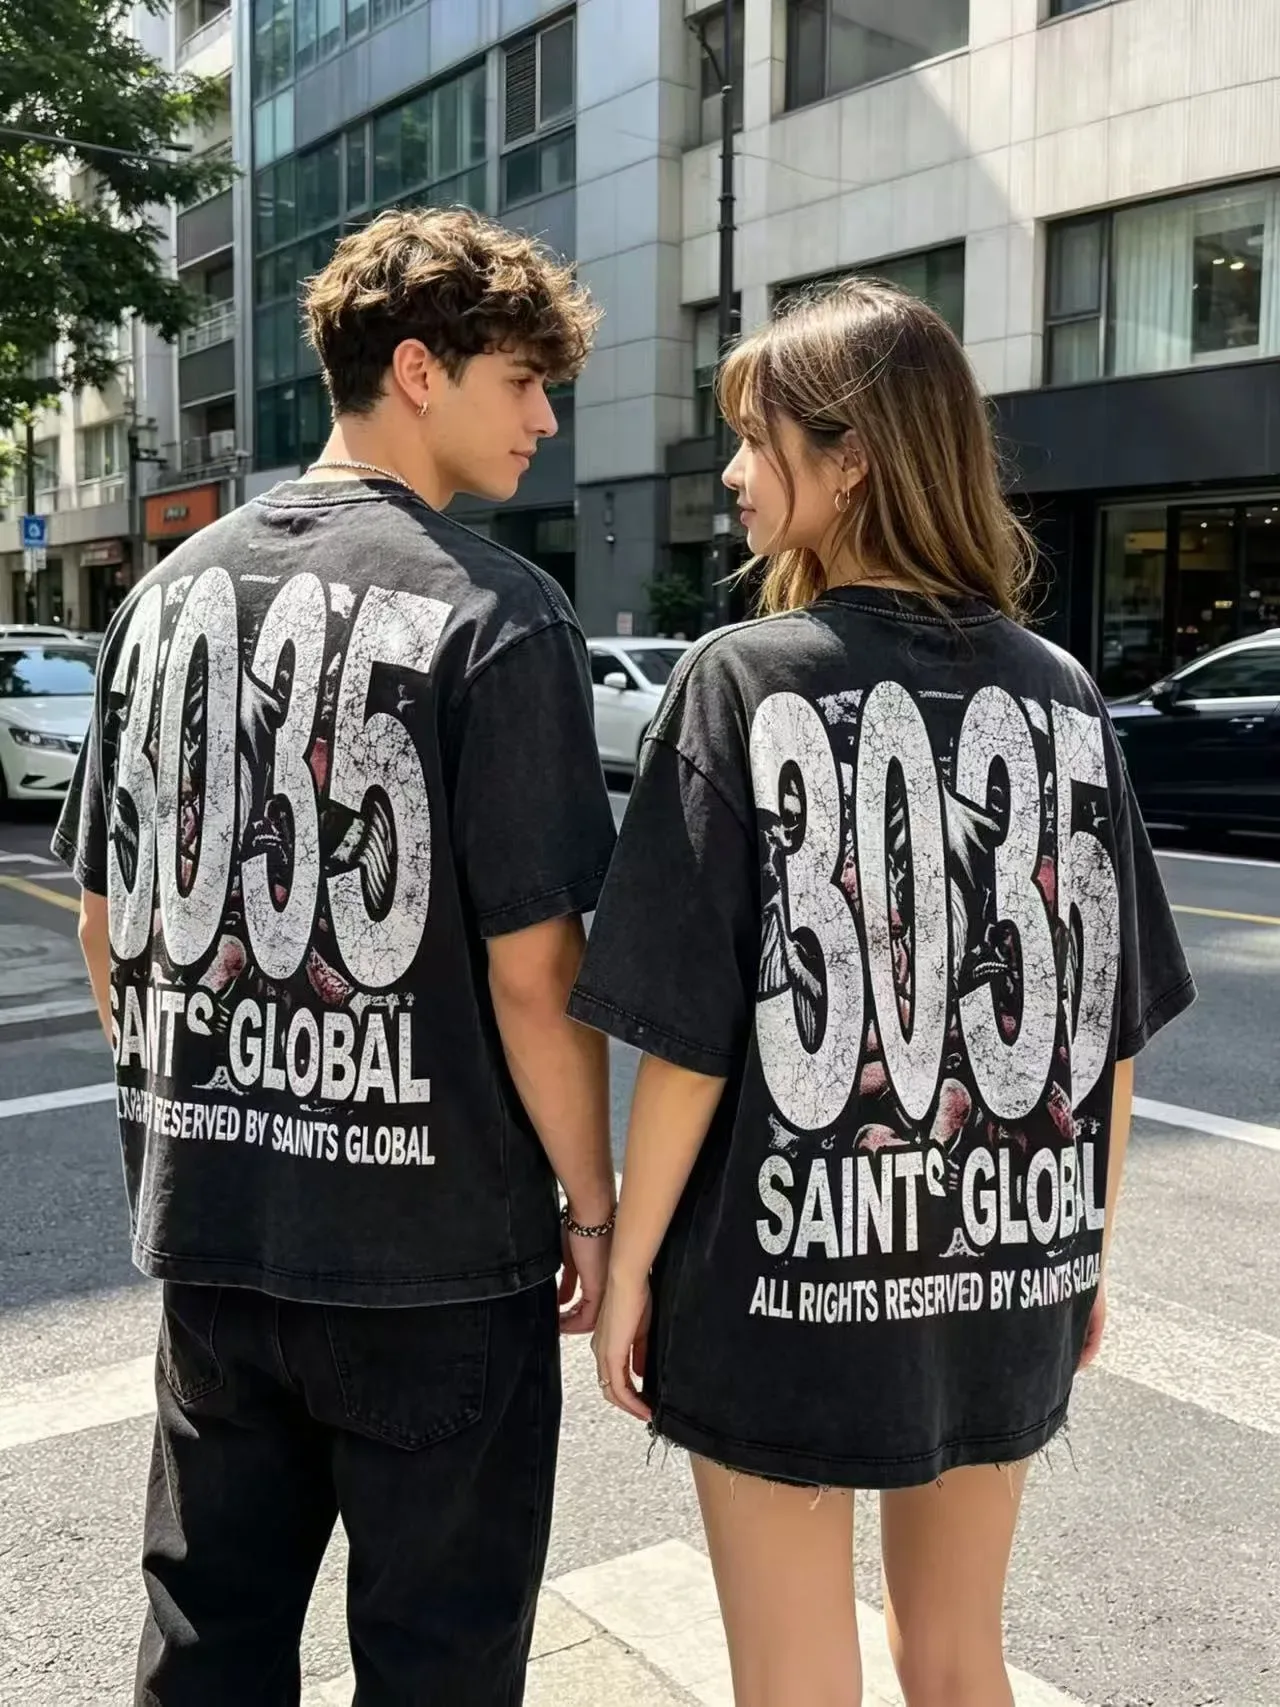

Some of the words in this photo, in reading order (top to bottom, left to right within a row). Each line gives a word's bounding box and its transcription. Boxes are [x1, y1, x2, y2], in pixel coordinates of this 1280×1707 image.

[106, 566, 454, 988] 3035
[749, 680, 1121, 1130] 3035
[229, 998, 431, 1105] GLOBAL
[244, 1108, 270, 1147] BY
[271, 1113, 340, 1162] SAINTS
[344, 1124, 436, 1166] GLOBAL
[748, 1275, 794, 1320] ALL
[798, 1278, 880, 1325] RIGHTS
[884, 1271, 984, 1321] RESERVED
[989, 1268, 1017, 1311] BY
[1019, 1259, 1073, 1310] SAINTS
